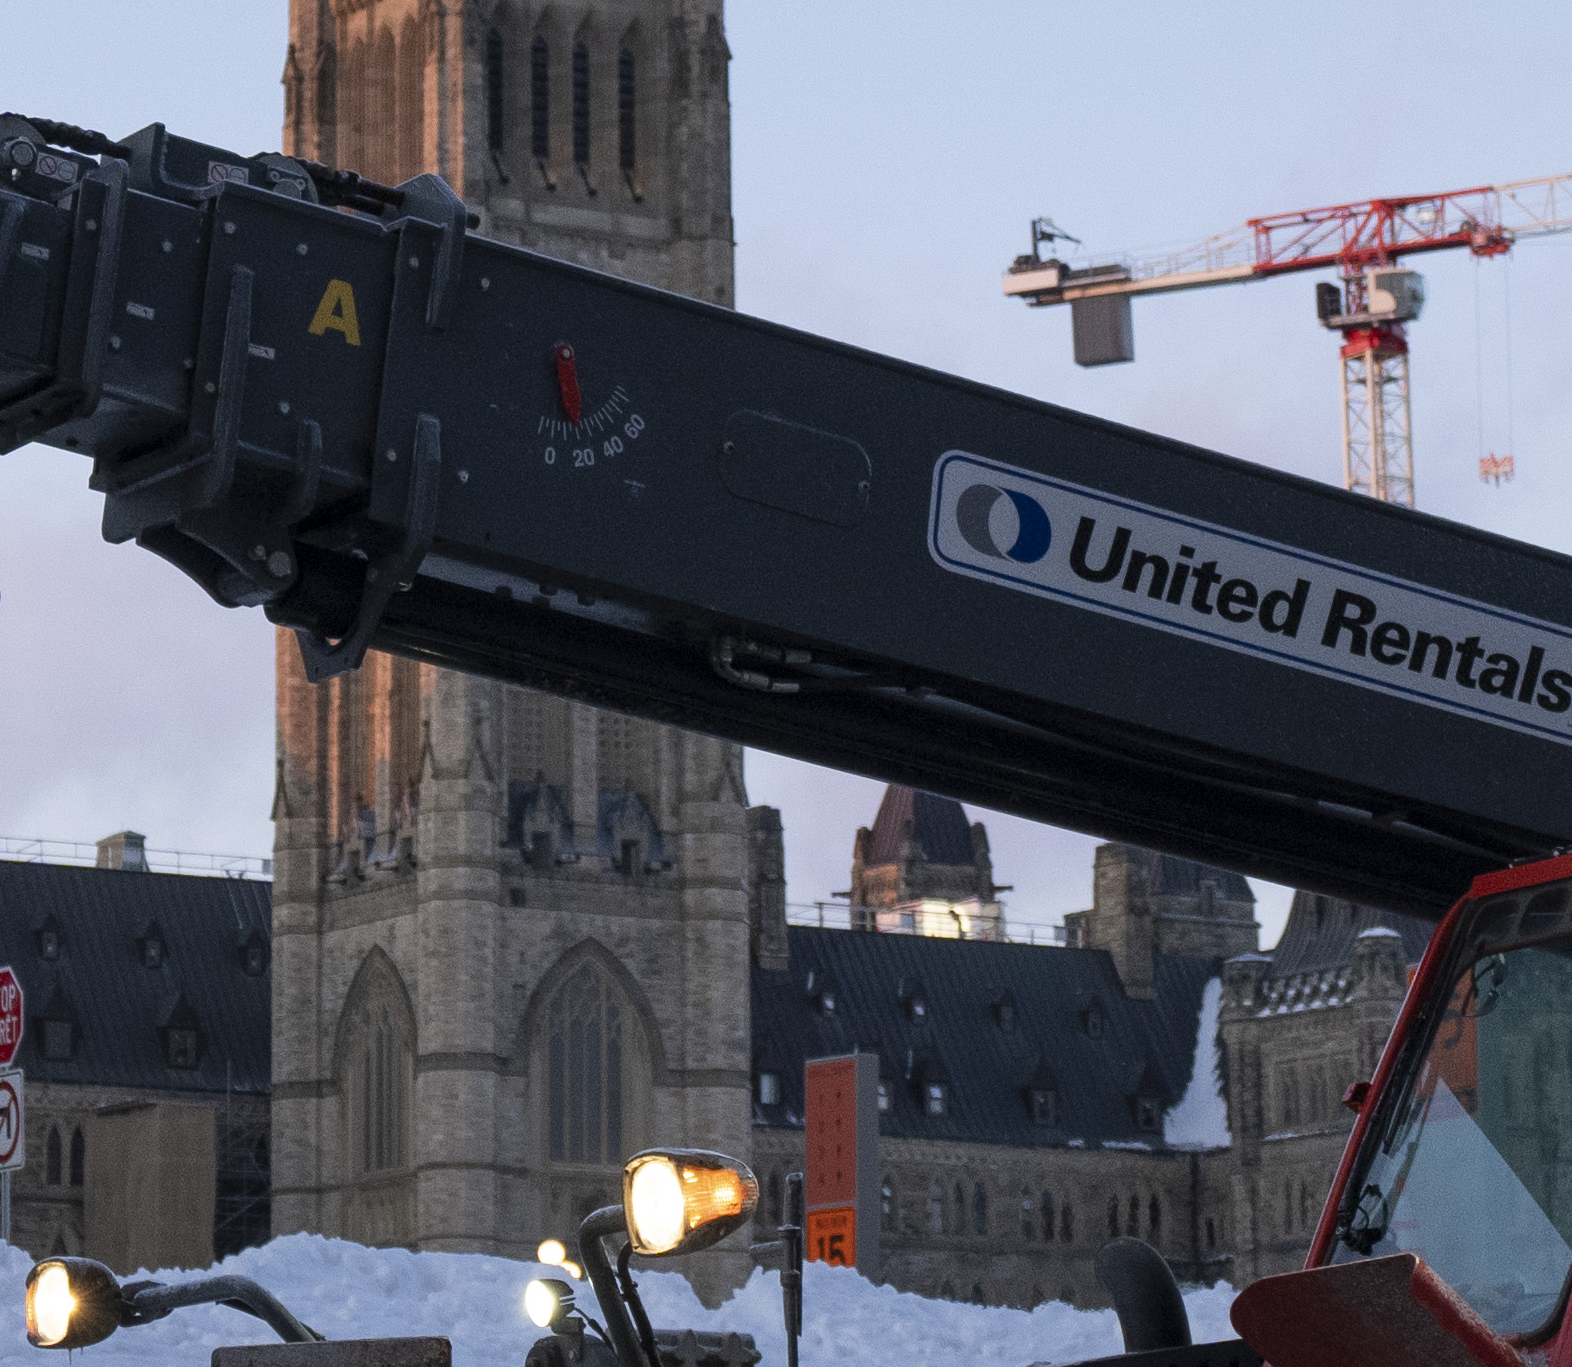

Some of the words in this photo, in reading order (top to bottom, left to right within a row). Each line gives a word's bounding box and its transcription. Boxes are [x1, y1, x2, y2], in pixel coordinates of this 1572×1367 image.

[307, 277, 362, 347] A
[572, 448, 596, 468] 20
[602, 435, 624, 458] 40
[624, 413, 645, 439] 60
[1069, 516, 1312, 639] United
